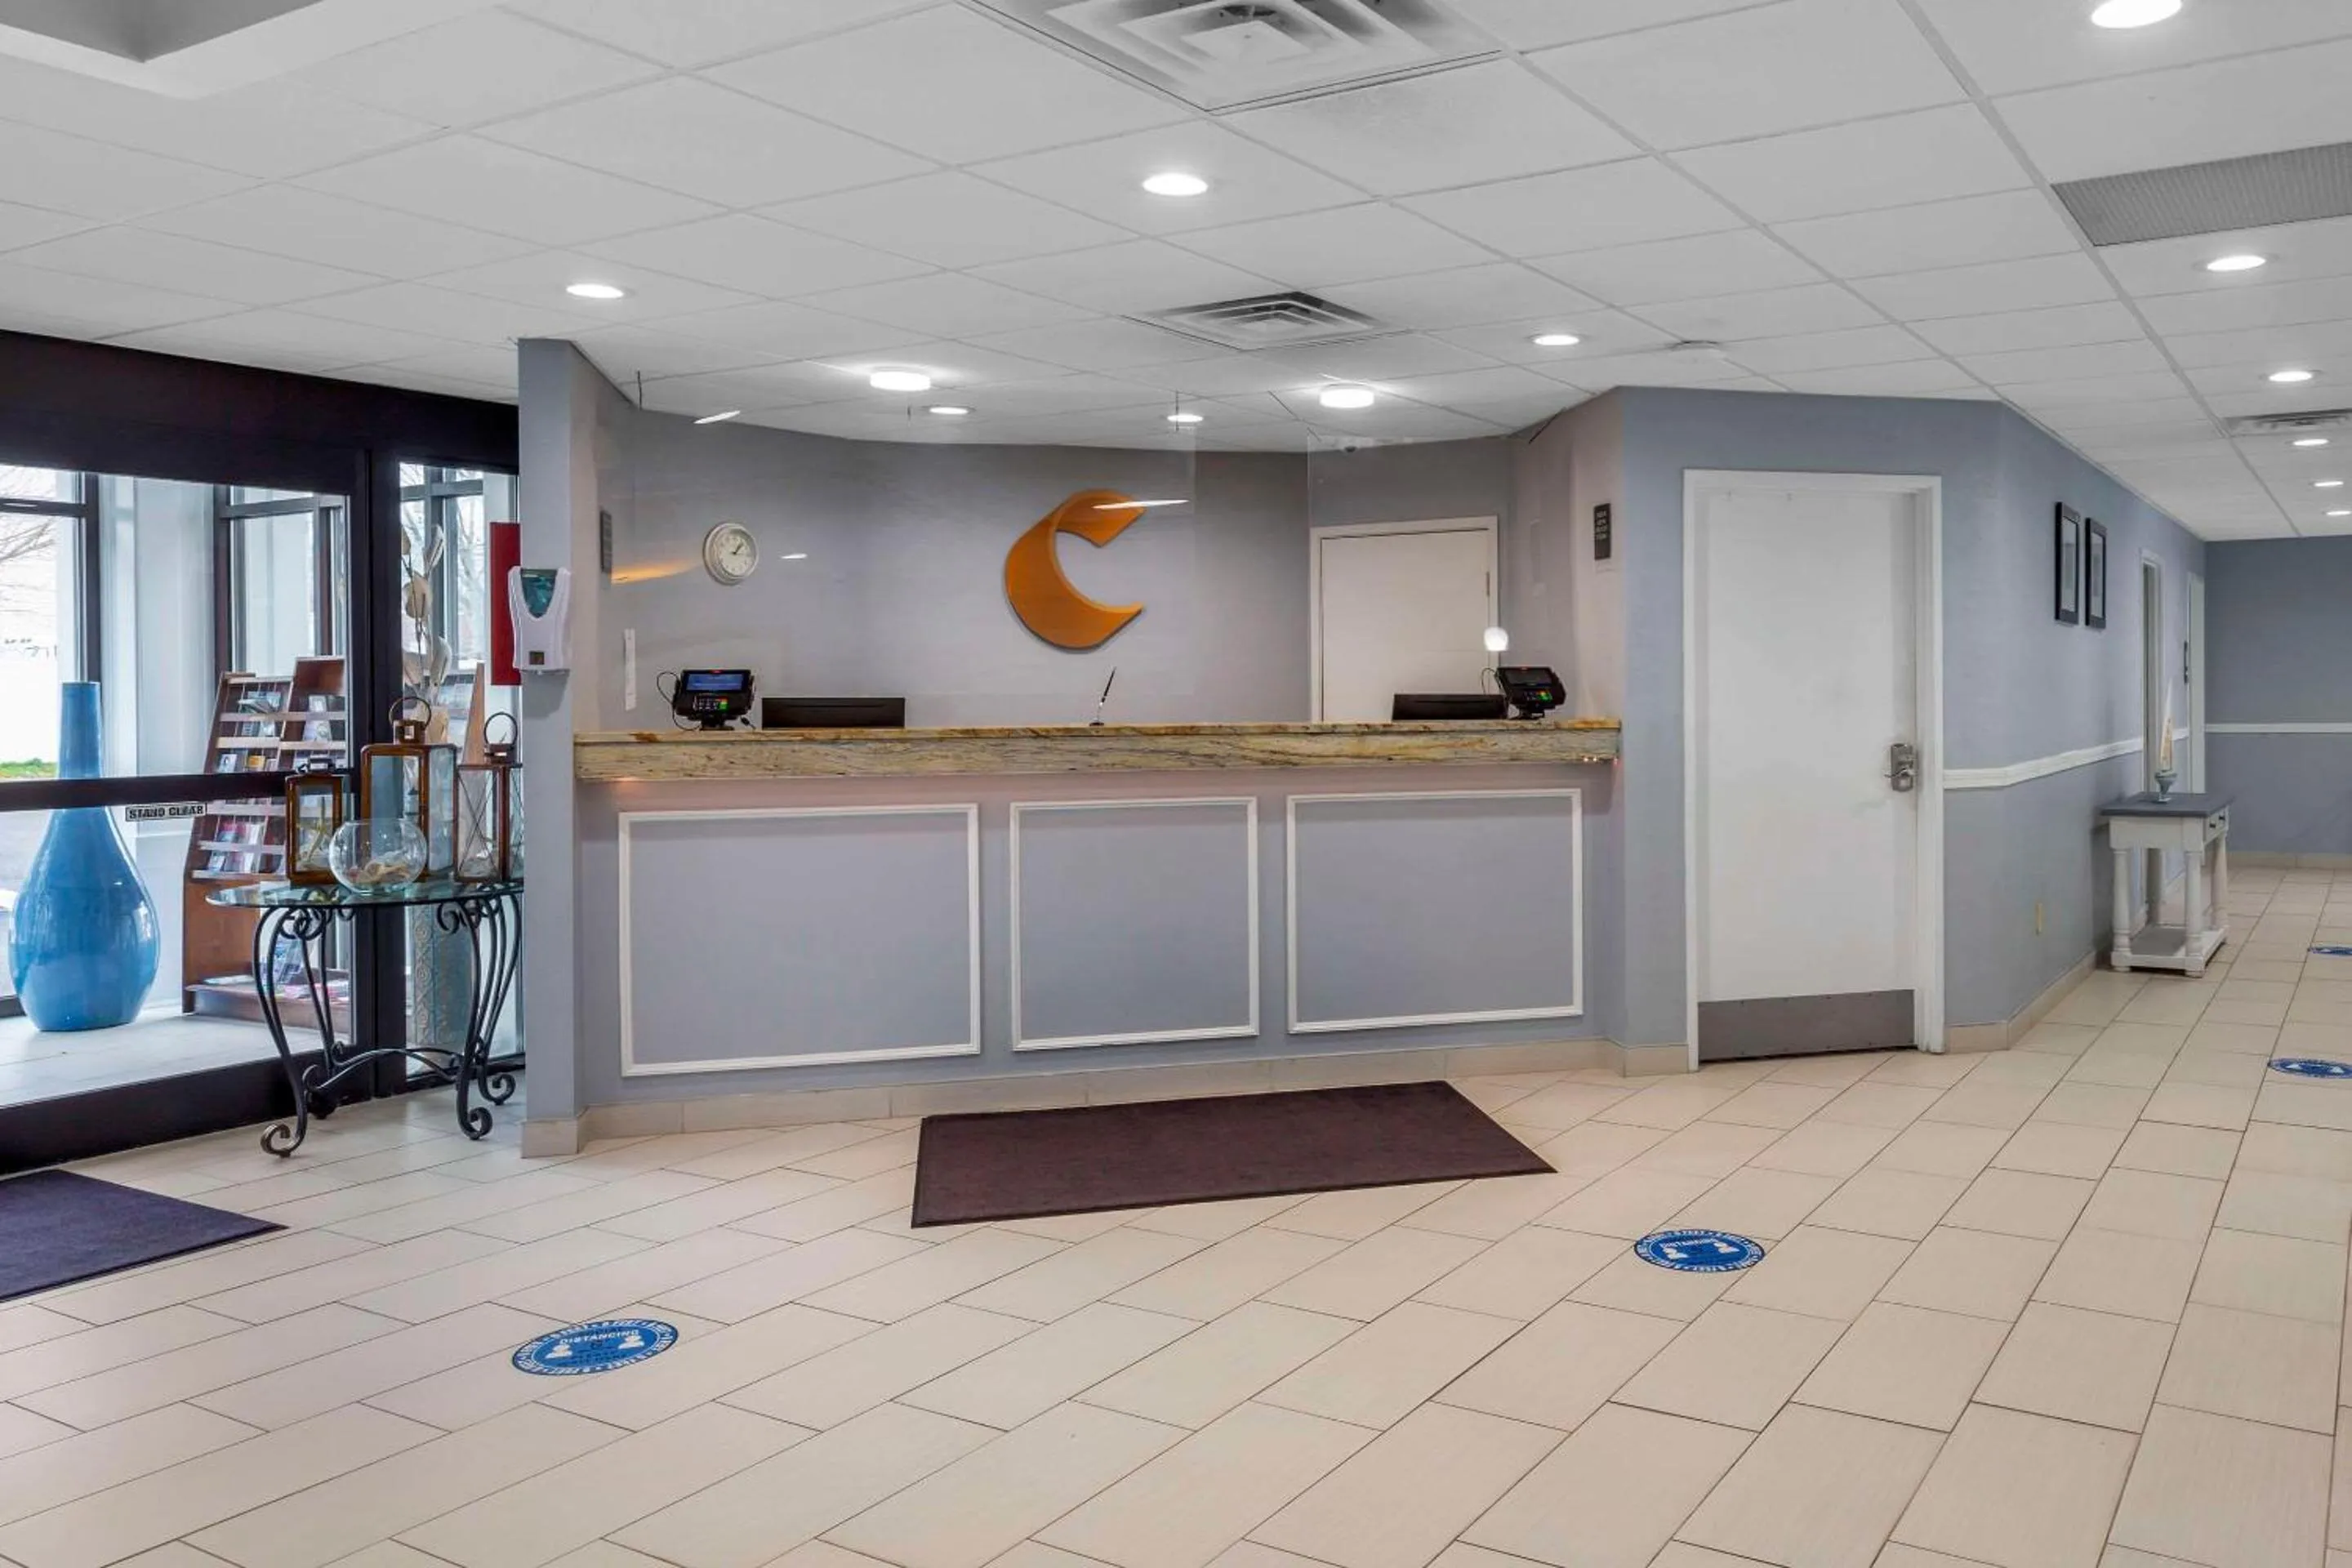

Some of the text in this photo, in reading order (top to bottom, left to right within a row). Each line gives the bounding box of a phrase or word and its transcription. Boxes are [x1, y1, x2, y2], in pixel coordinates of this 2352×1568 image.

[129, 804, 203, 819] STAND CLEAR
[560, 1330, 639, 1344] DISTANCING
